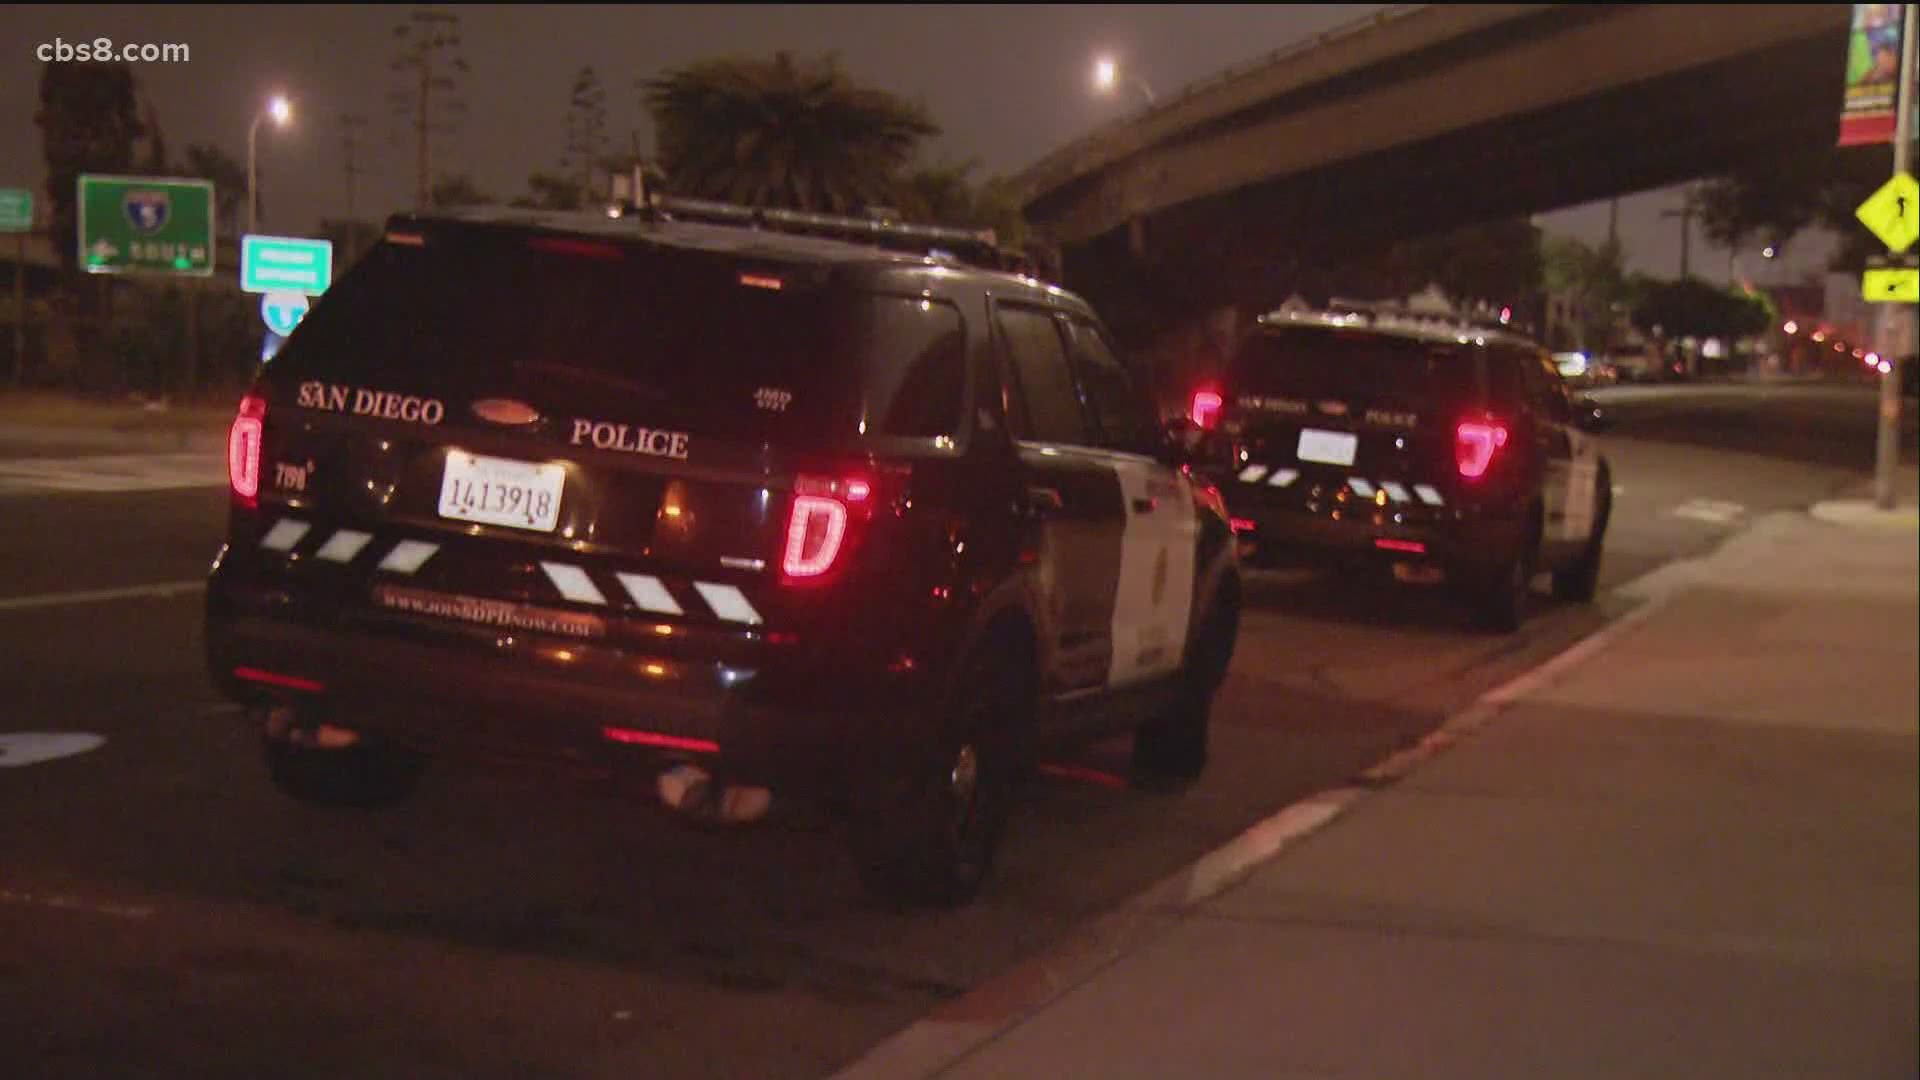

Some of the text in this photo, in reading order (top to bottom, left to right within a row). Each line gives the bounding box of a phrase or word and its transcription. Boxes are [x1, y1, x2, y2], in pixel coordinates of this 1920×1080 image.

[297, 380, 445, 425] SAN DIEGO
[569, 418, 689, 459] POLICE
[448, 478, 551, 519] 1413918
